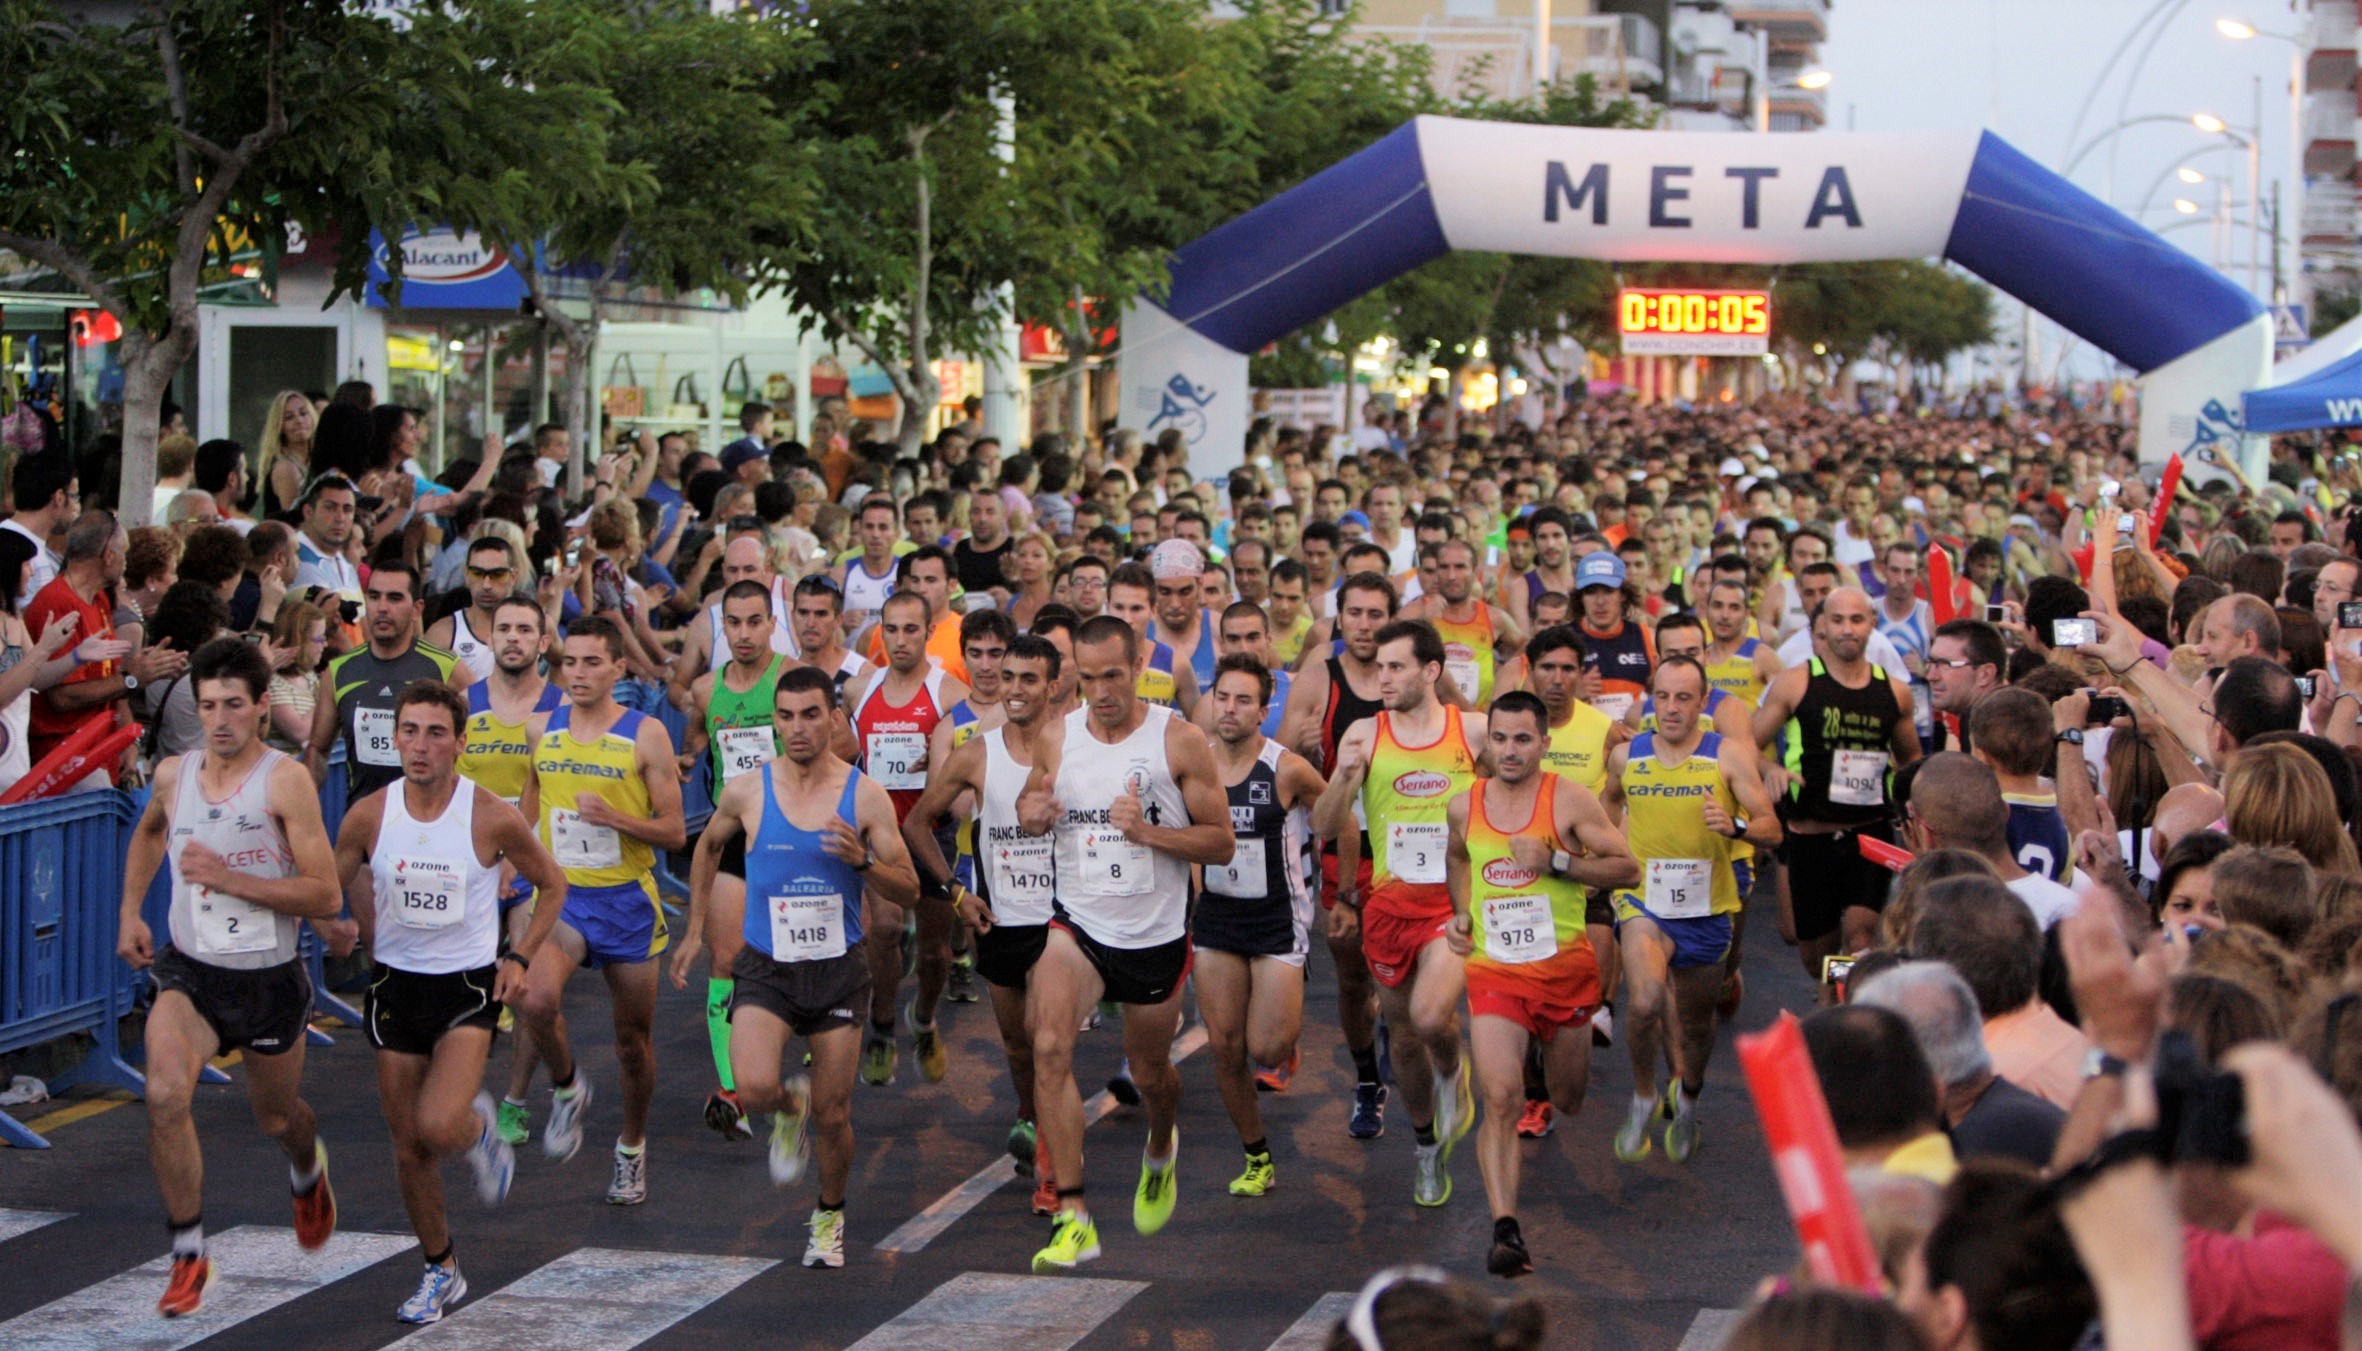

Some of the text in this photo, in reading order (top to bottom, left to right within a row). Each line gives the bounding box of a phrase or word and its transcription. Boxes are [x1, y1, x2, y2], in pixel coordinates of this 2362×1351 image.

[1543, 160, 1863, 229] META
[1621, 293, 1768, 334] 0:00:05
[372, 712, 396, 720] ozon
[1823, 706, 1840, 738] 28
[466, 740, 531, 756] cafem
[736, 754, 763, 770] 455
[1543, 751, 1592, 761] ERSWORLD
[538, 760, 628, 780] cafemax
[887, 761, 906, 774] 70
[1399, 778, 1448, 792] Serrano
[1627, 783, 1715, 798] cafemax
[1068, 809, 1098, 825] FRANC
[989, 826, 1015, 842] FRANC
[1406, 825, 1441, 834] ozone
[582, 839, 589, 853] 1
[1099, 835, 1127, 843] ozon
[217, 849, 268, 868] ACETE
[1013, 847, 1048, 856] ozone
[411, 861, 450, 872] ozone
[1416, 852, 1427, 867] 3
[1664, 862, 1698, 870] ozone
[1110, 863, 1122, 878] 8
[1228, 867, 1239, 882] 9
[1486, 864, 1535, 880] Serrano
[782, 883, 835, 894] BALEARIA
[1010, 873, 1050, 889] 1470
[403, 890, 448, 911] 1528
[1670, 888, 1686, 903] 15
[791, 899, 828, 909] ozone
[1498, 900, 1534, 911] ozone
[226, 917, 240, 934] 2
[789, 926, 828, 944] 1418
[1501, 927, 1535, 946] 978
